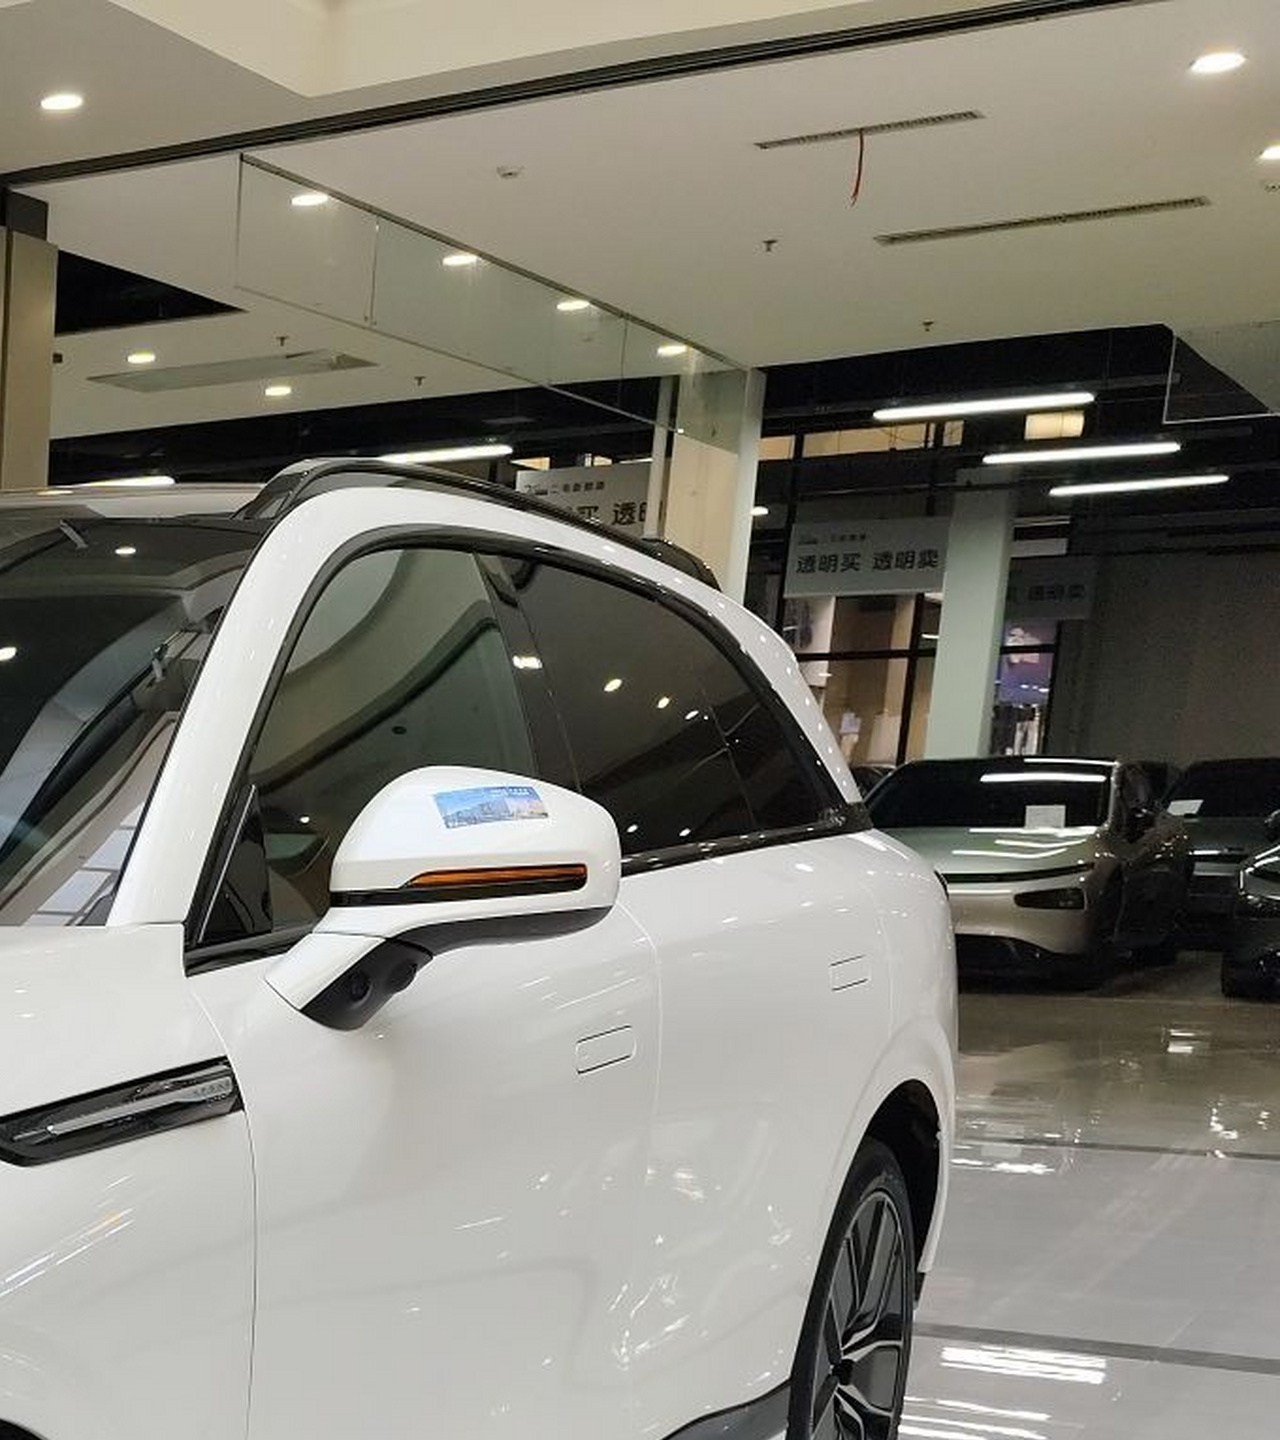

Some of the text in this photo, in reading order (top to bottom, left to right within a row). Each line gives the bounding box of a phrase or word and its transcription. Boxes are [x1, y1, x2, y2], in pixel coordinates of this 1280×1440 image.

[796, 548, 939, 574] 透明买 透明卖
